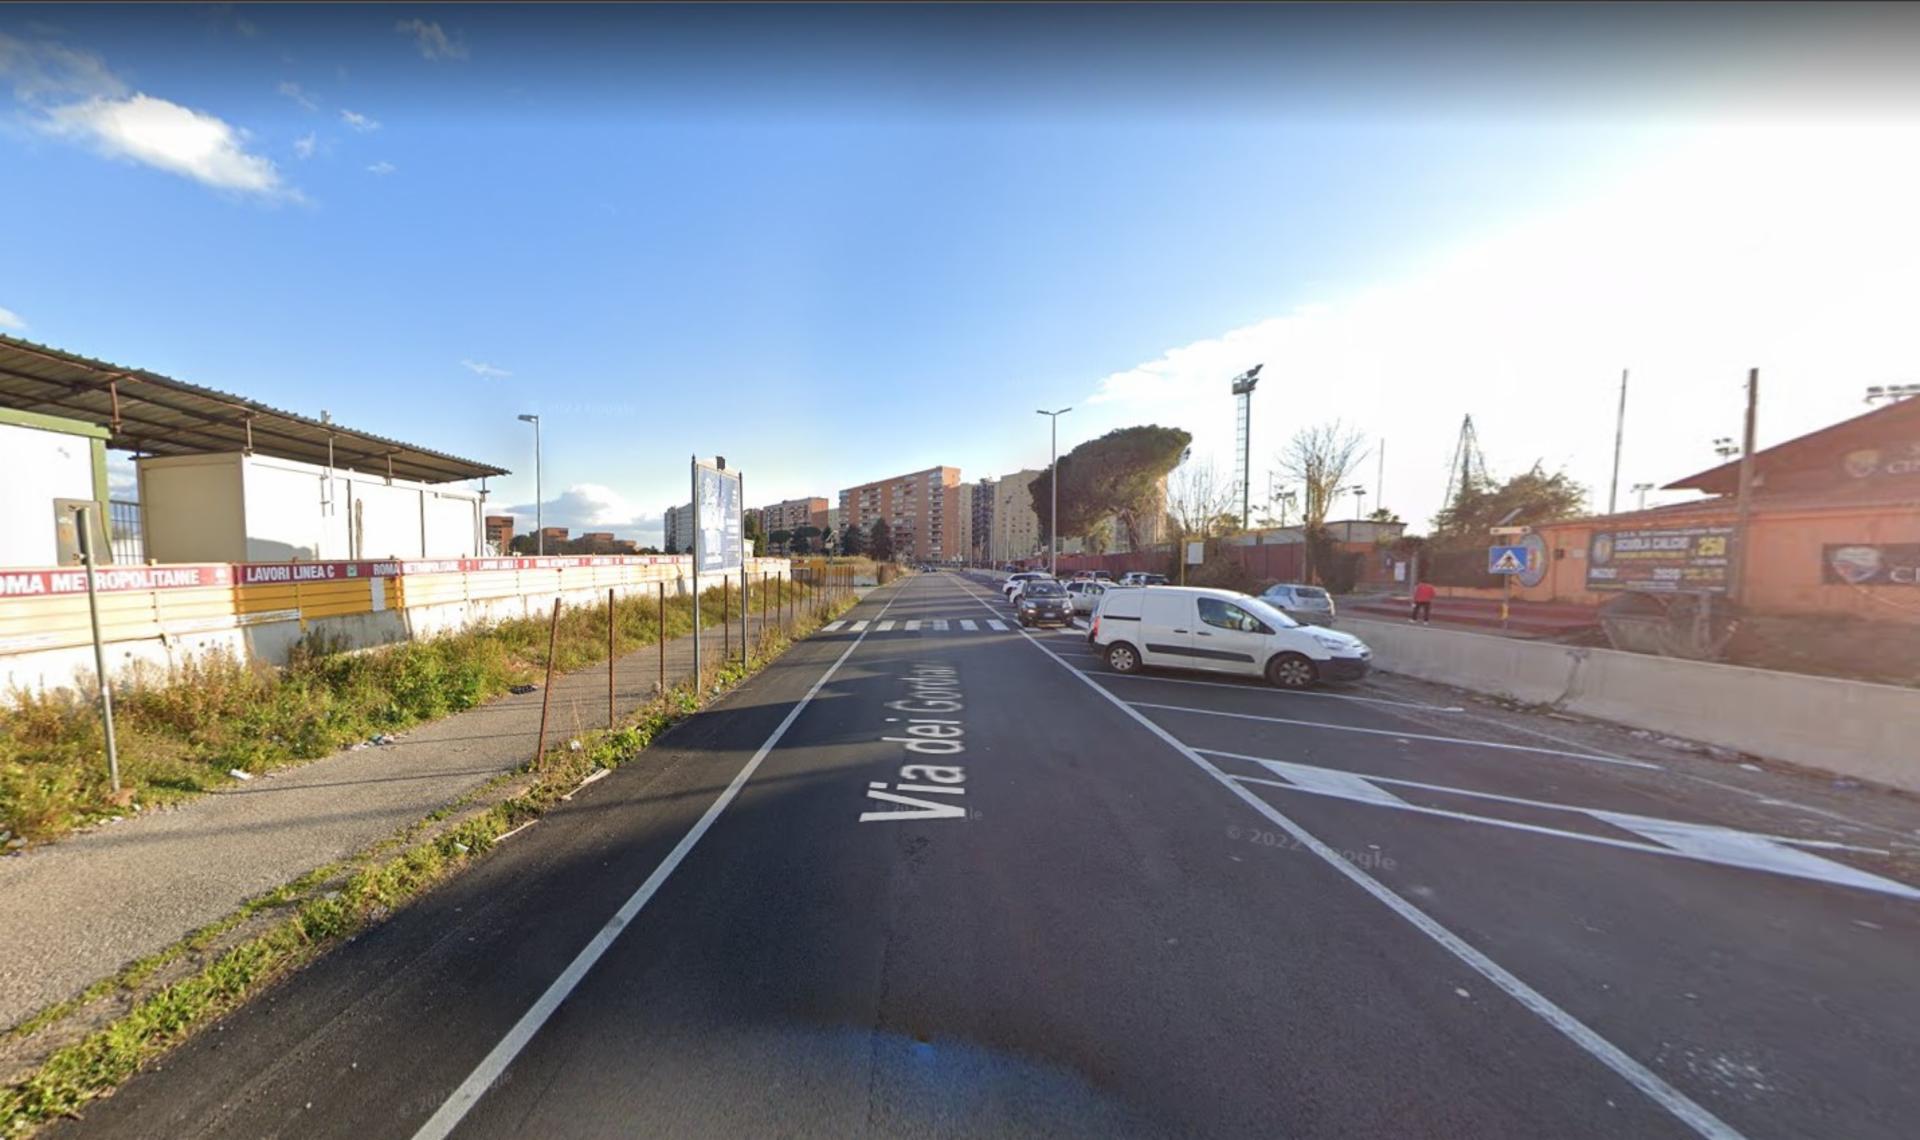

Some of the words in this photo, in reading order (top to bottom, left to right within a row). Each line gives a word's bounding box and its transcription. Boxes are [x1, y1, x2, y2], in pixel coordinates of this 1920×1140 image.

[51, 569, 200, 593] MEROPOLITANE
[246, 565, 290, 582] LAVORI
[293, 565, 325, 580] LINEA
[327, 565, 336, 578] C
[373, 563, 400, 577] ROMA
[883, 662, 964, 713] Gordian
[881, 717, 966, 755] dei
[859, 764, 966, 823] Via
